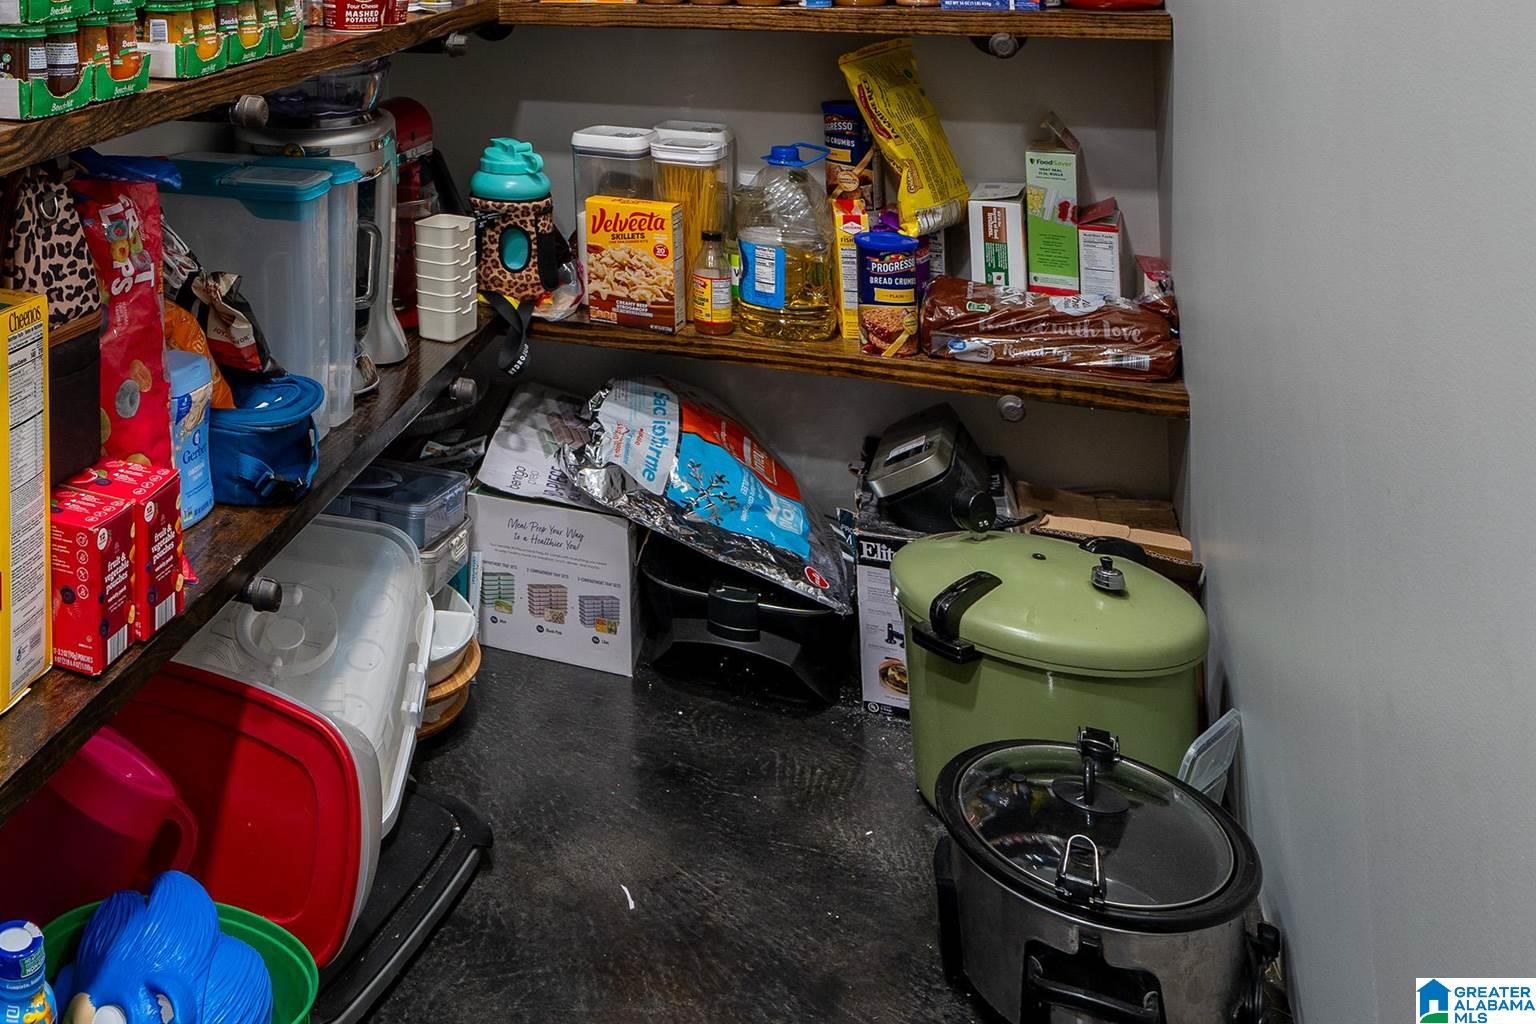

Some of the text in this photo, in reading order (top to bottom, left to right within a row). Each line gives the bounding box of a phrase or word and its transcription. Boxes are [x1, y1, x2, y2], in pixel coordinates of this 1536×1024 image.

[345, 10, 379, 18] MASHED
[830, 137, 856, 147] CRUMBS
[1036, 158, 1073, 167] FoodSaver
[591, 207, 666, 235] Velveeta
[610, 232, 646, 240] SKILLETS
[869, 275, 892, 285] BREAD
[615, 299, 637, 307] CREAMY
[888, 292, 905, 300] PLAIN
[7, 304, 42, 333] Cheerios
[616, 305, 649, 313] STROGANOFF
[1103, 322, 1144, 343] Love
[154, 523, 172, 544] fruit &
[507, 517, 585, 542] Meal Prep Your Way
[513, 532, 520, 541] to
[530, 533, 564, 548] Healthier
[151, 532, 176, 553] vegetable
[107, 551, 127, 572] fruit &
[152, 542, 175, 565] pouches
[104, 560, 130, 585] vegetable
[105, 571, 129, 595] pouches
